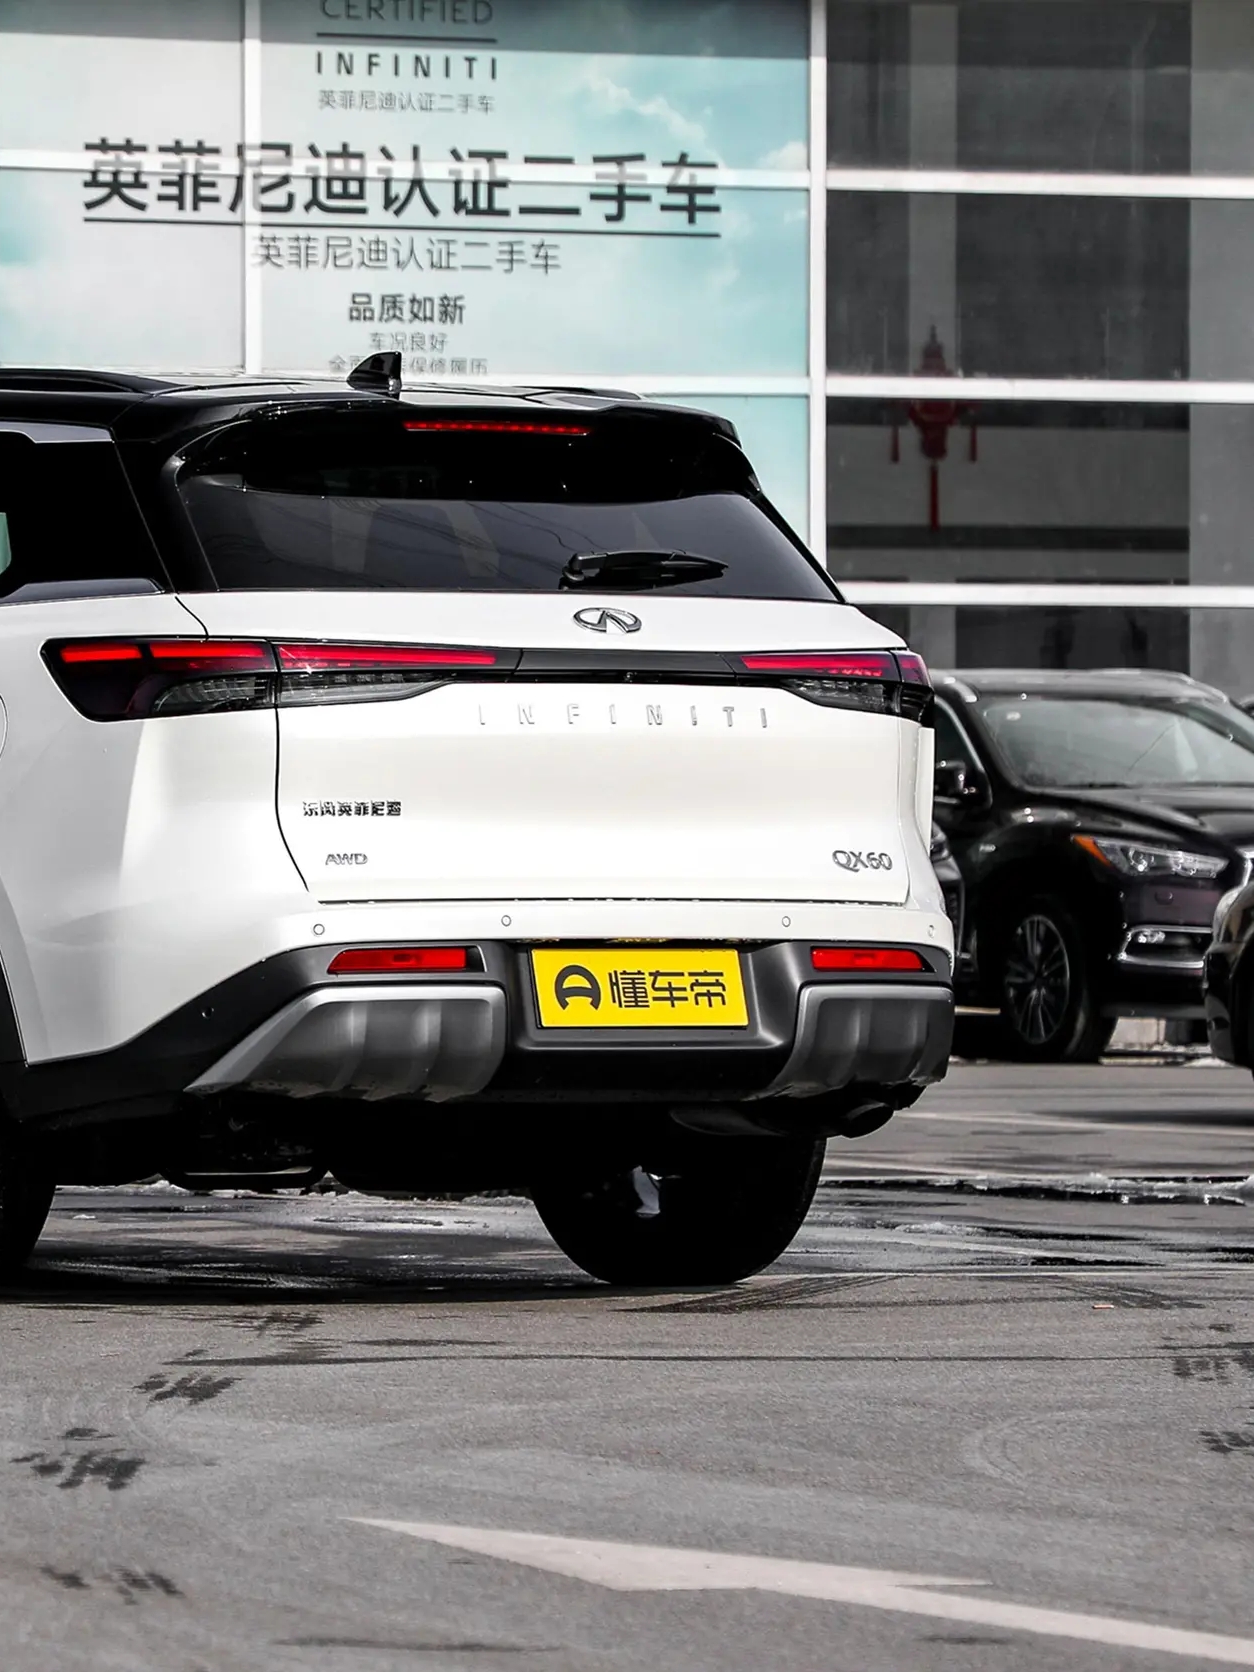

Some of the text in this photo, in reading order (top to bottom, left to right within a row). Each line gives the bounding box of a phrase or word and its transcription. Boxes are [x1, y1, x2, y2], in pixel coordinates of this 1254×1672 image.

[319, 0, 493, 24] CERTIFIED
[316, 51, 497, 80] INFINITI
[318, 89, 496, 115] 英菲尼迪认证二手车
[83, 137, 721, 225] 英菲尼迪认证二手车
[252, 233, 561, 274] 英菲尼迪认证二手车
[348, 293, 466, 325] 品质如新
[369, 331, 449, 353] 车况良好
[478, 703, 768, 728] INFINITI
[302, 800, 402, 817] 东风英菲尼迪
[325, 853, 369, 866] AWD
[832, 850, 893, 873] QX60
[608, 969, 727, 1009] 懂车帝
